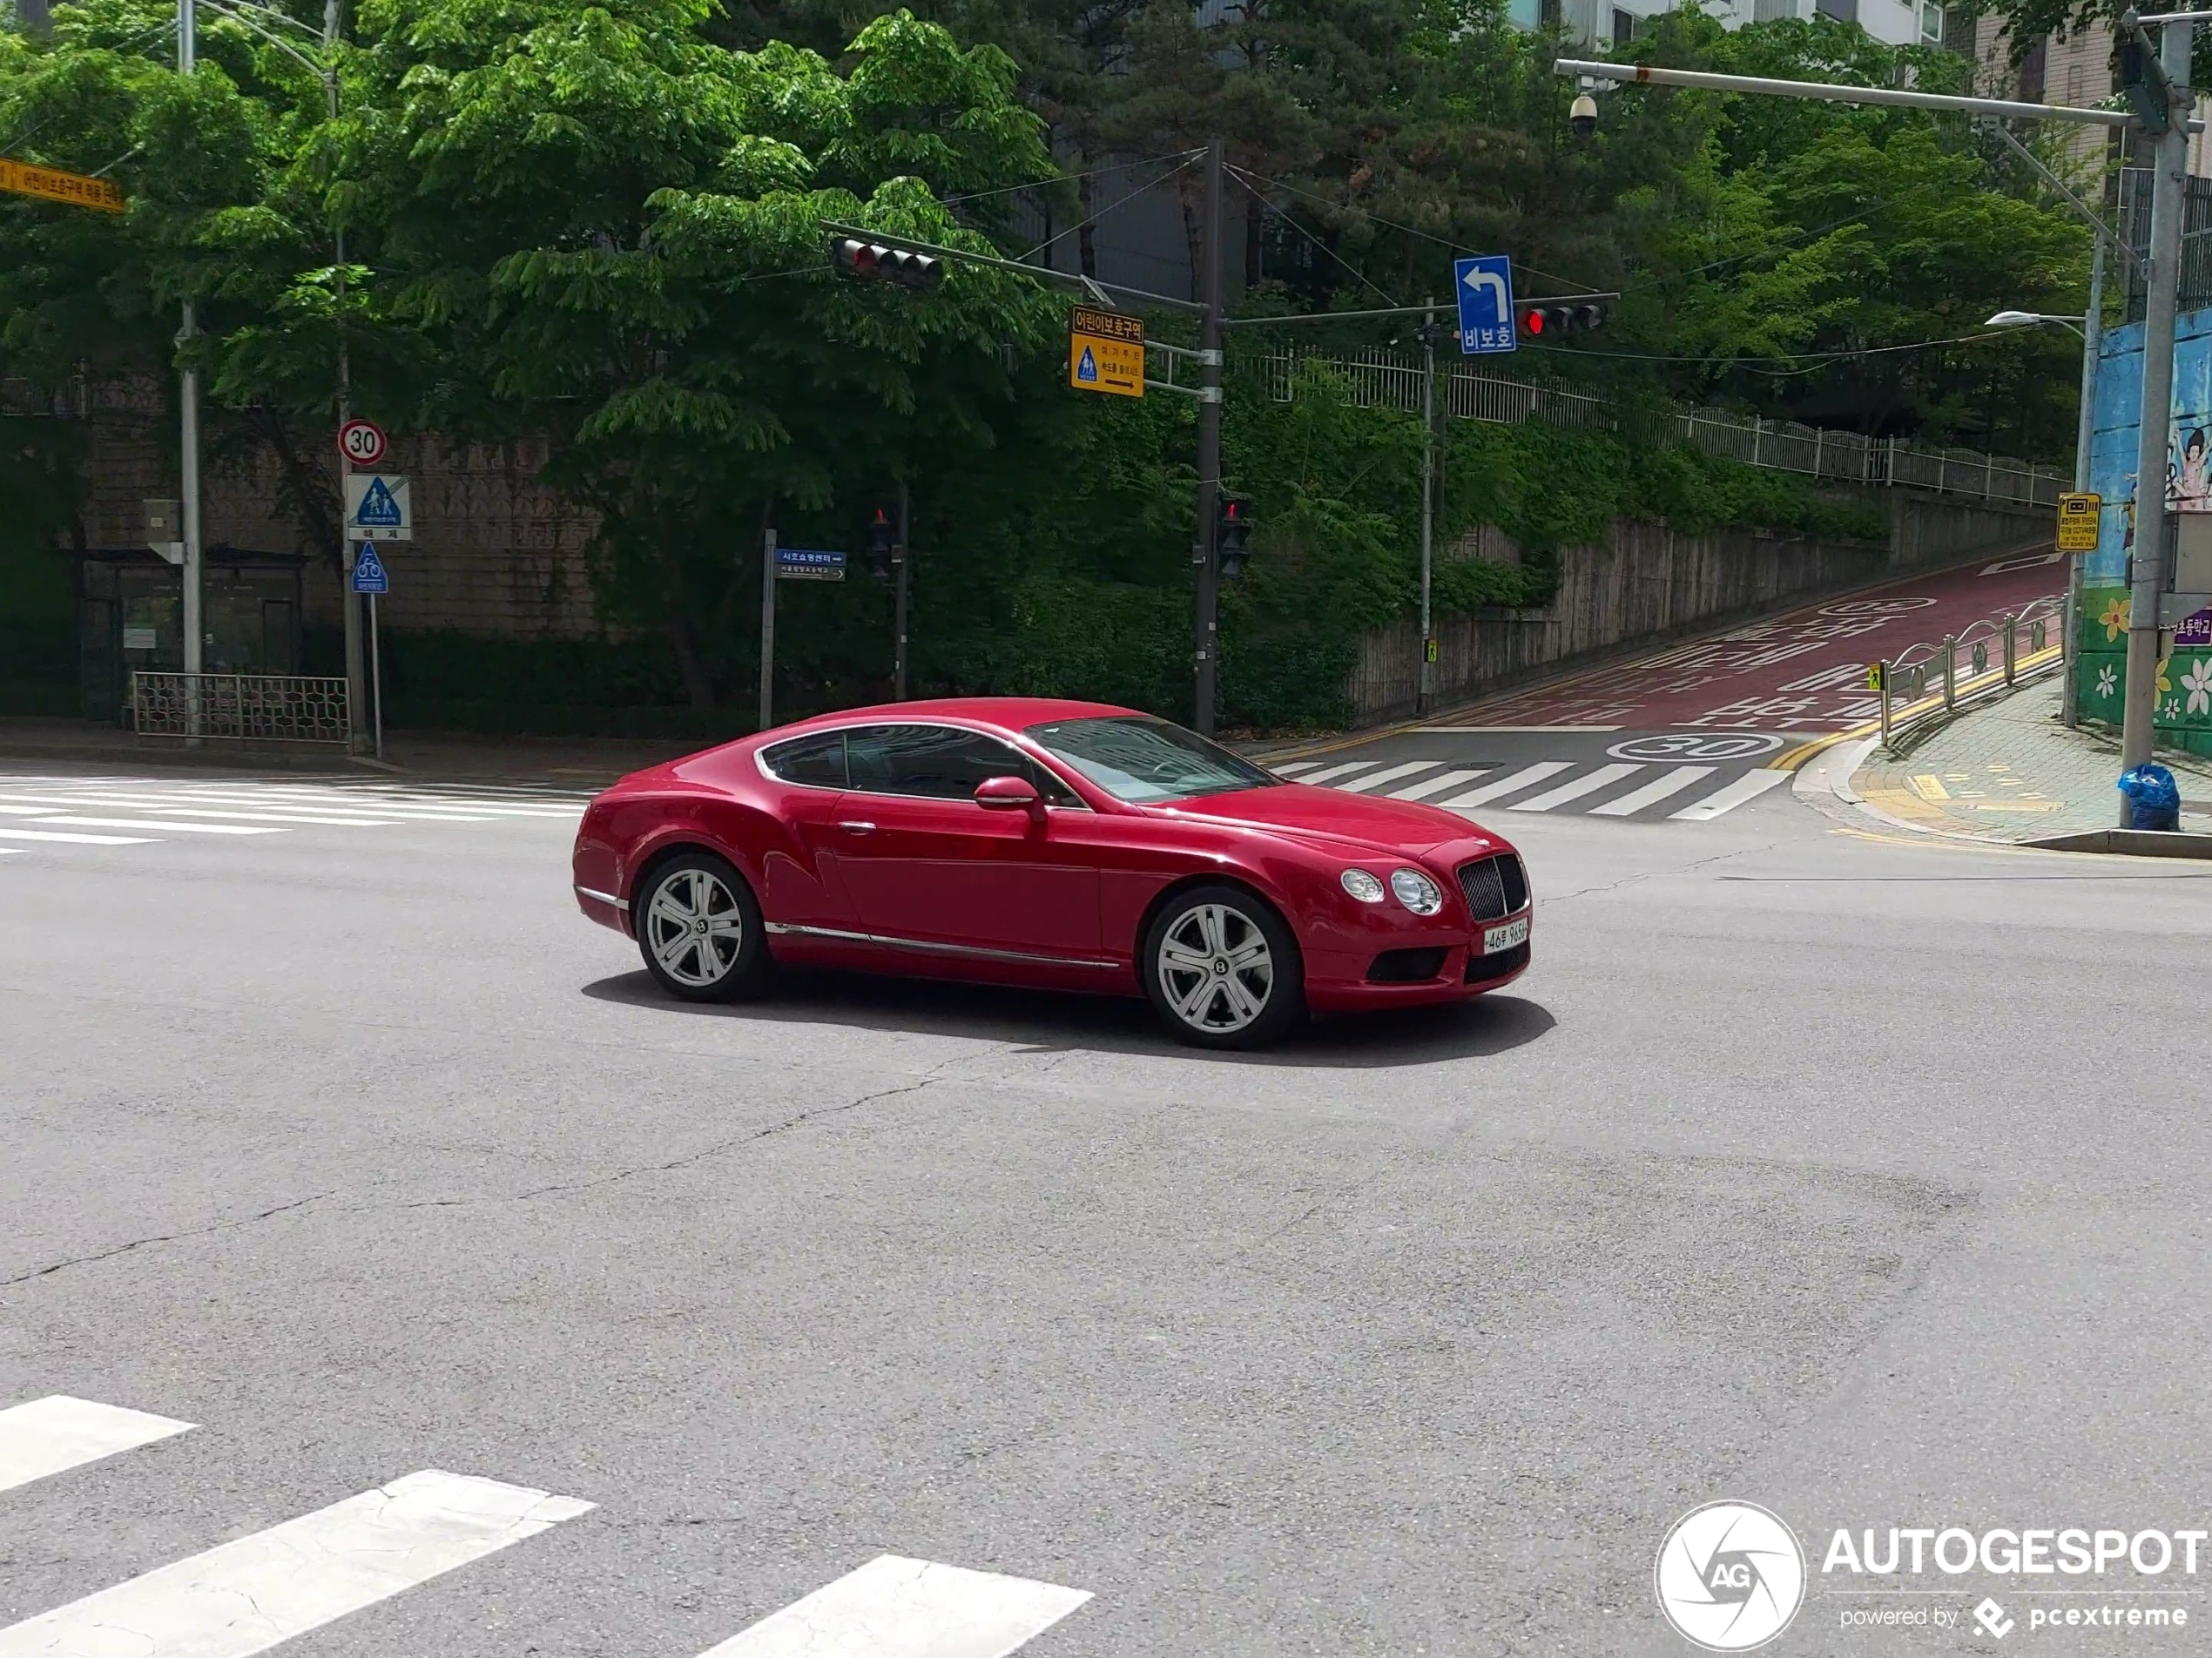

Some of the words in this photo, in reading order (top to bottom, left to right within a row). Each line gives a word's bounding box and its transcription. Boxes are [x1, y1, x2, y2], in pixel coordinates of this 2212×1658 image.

[1076, 312, 1141, 340] 어린이보호구역
[1465, 327, 1512, 349] 비보호
[350, 430, 375, 454] 30
[1628, 737, 1755, 758] 30
